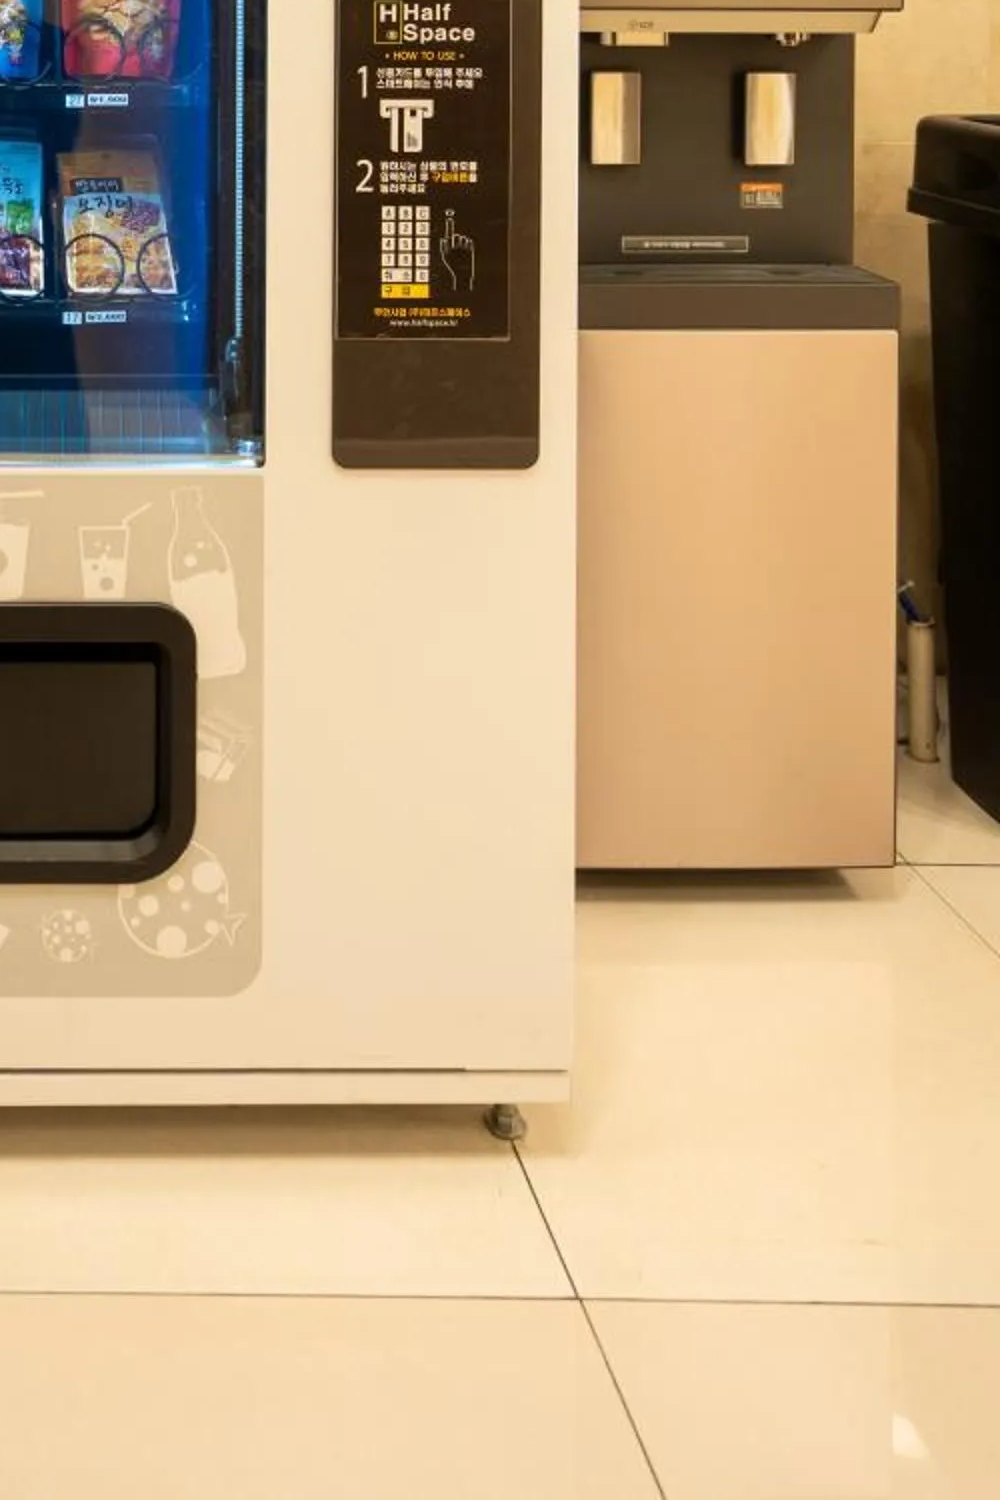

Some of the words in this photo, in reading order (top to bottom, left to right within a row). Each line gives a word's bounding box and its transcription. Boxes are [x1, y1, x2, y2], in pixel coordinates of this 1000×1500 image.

[379, 3, 398, 22] H
[403, 3, 452, 21] Half
[402, 23, 476, 44] Space
[393, 52, 418, 61] HOW
[421, 52, 434, 61] TO
[437, 52, 457, 61] USE
[357, 65, 368, 98] 1
[356, 159, 375, 193] 2
